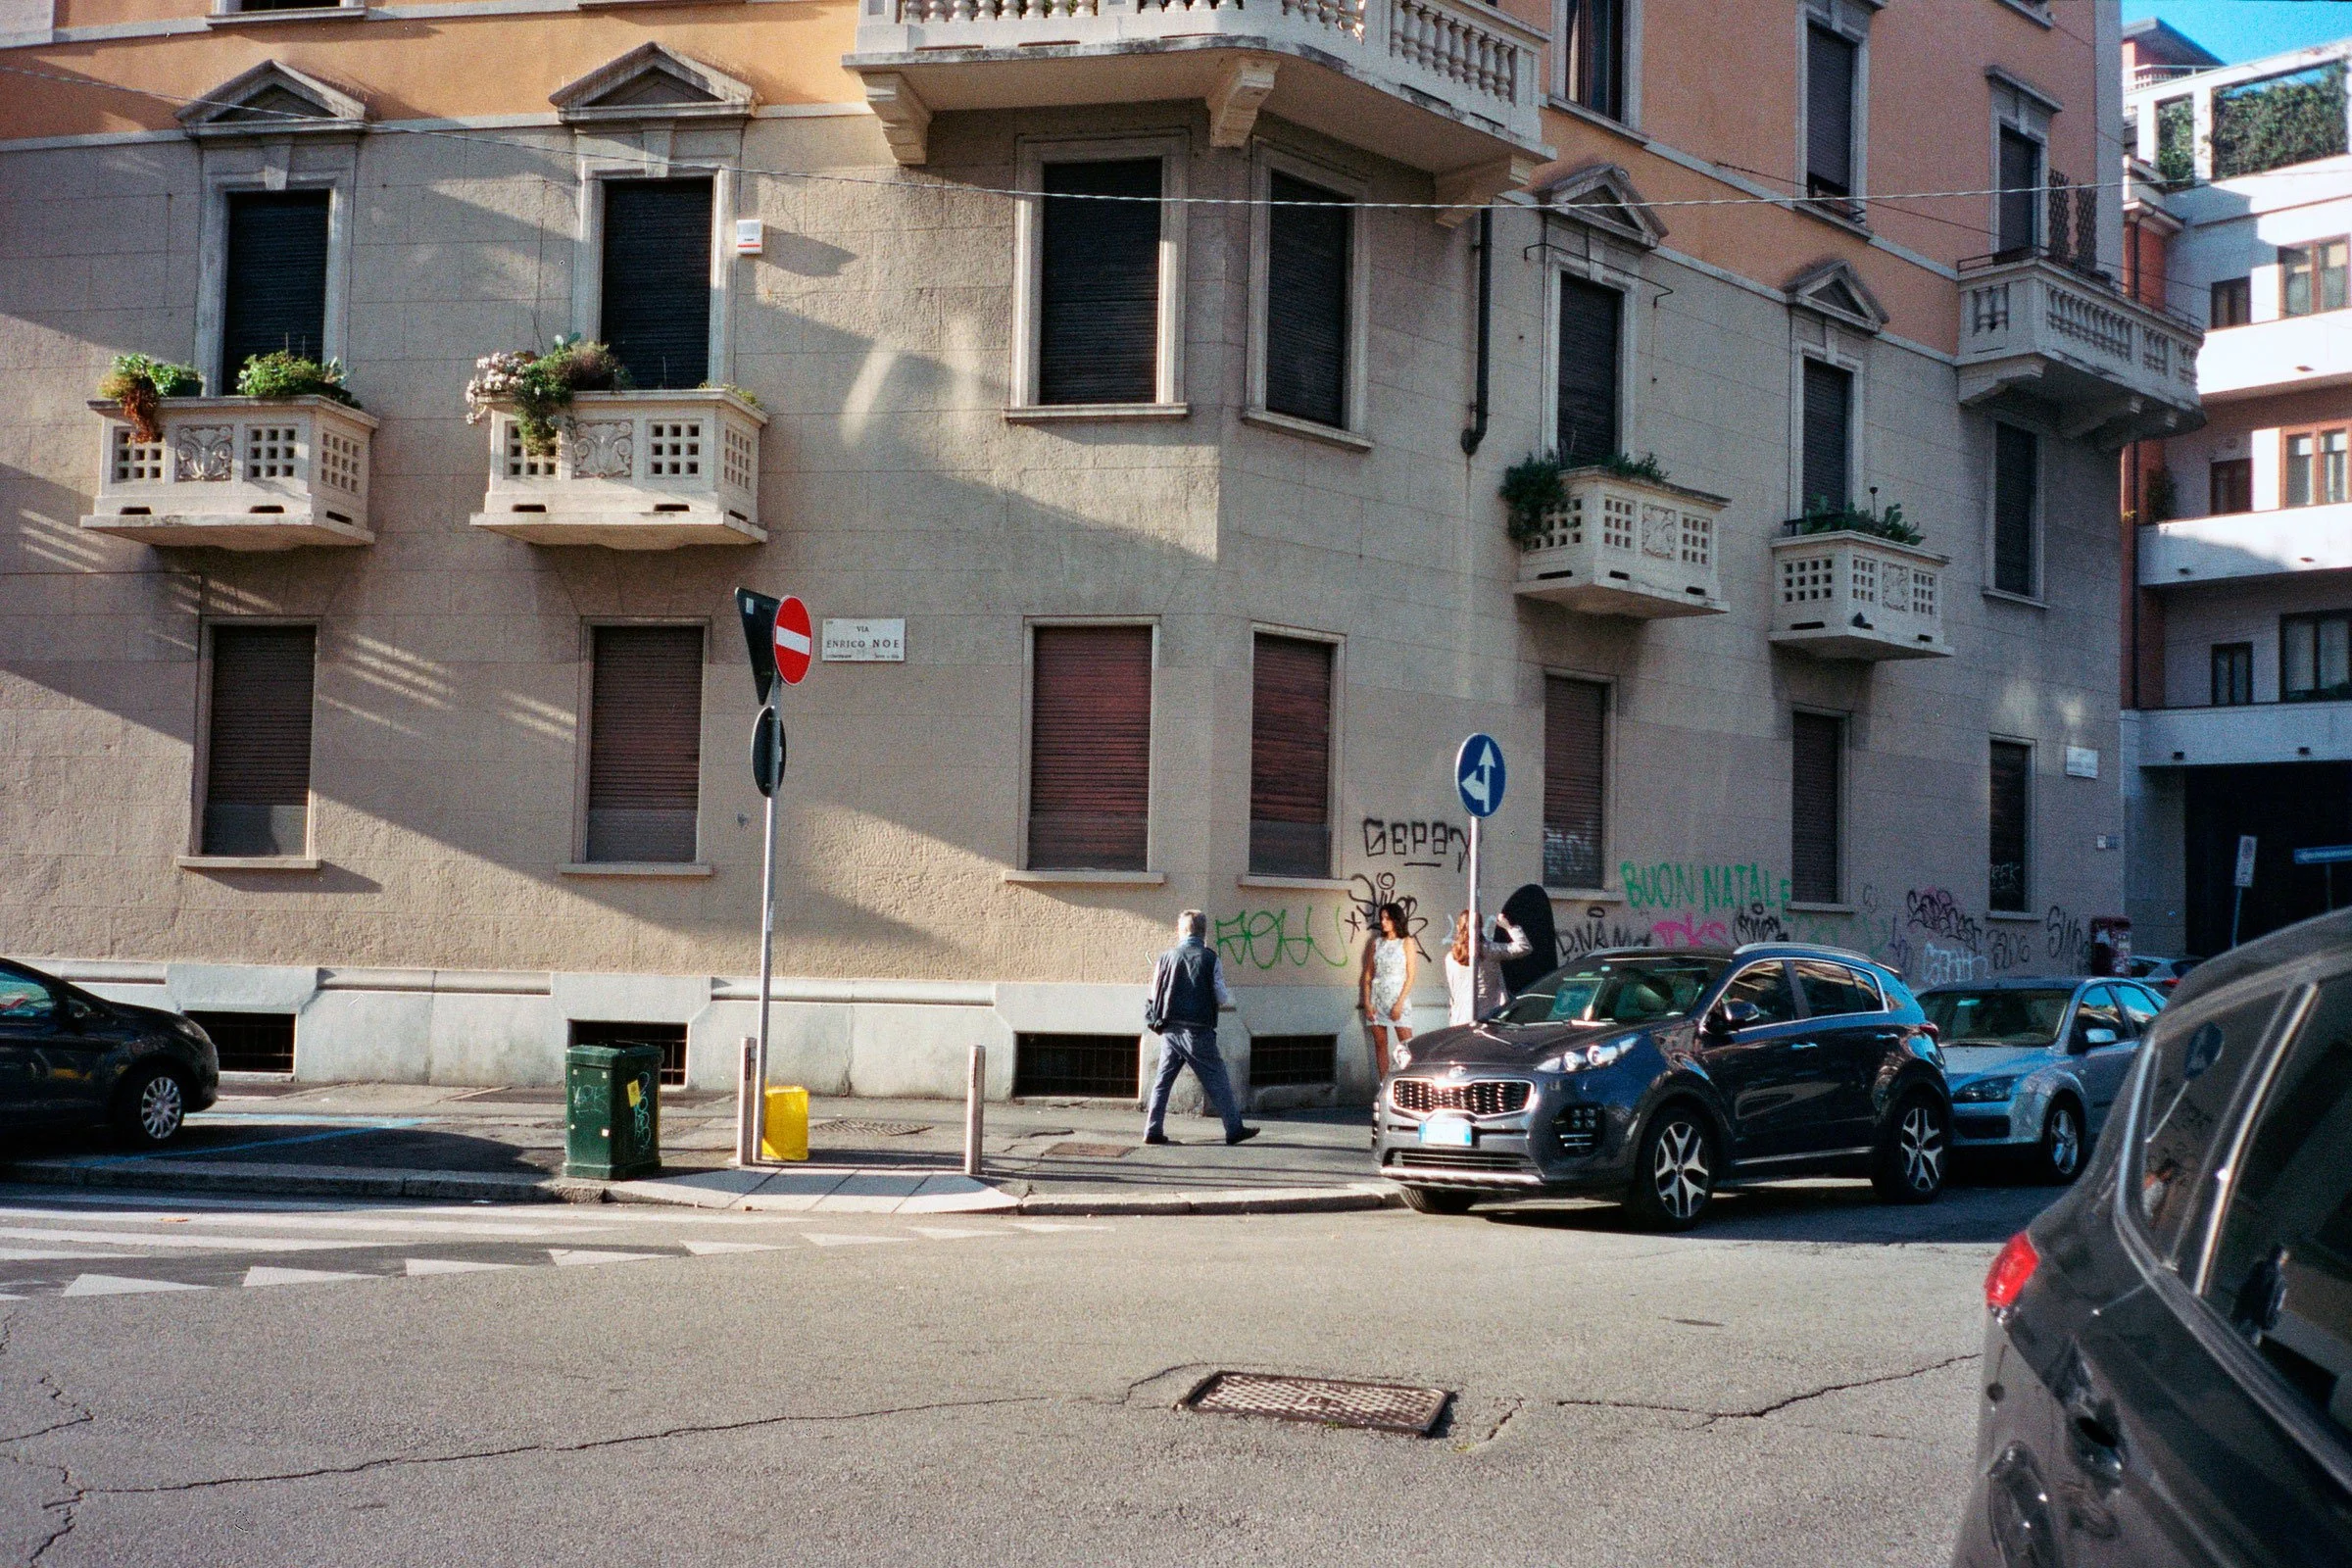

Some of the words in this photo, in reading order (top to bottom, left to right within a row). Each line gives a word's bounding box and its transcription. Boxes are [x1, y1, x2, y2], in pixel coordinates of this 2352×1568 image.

[826, 639, 865, 648] ENRICO
[1619, 860, 1695, 909] BUON
[1702, 861, 1793, 921] NATALE
